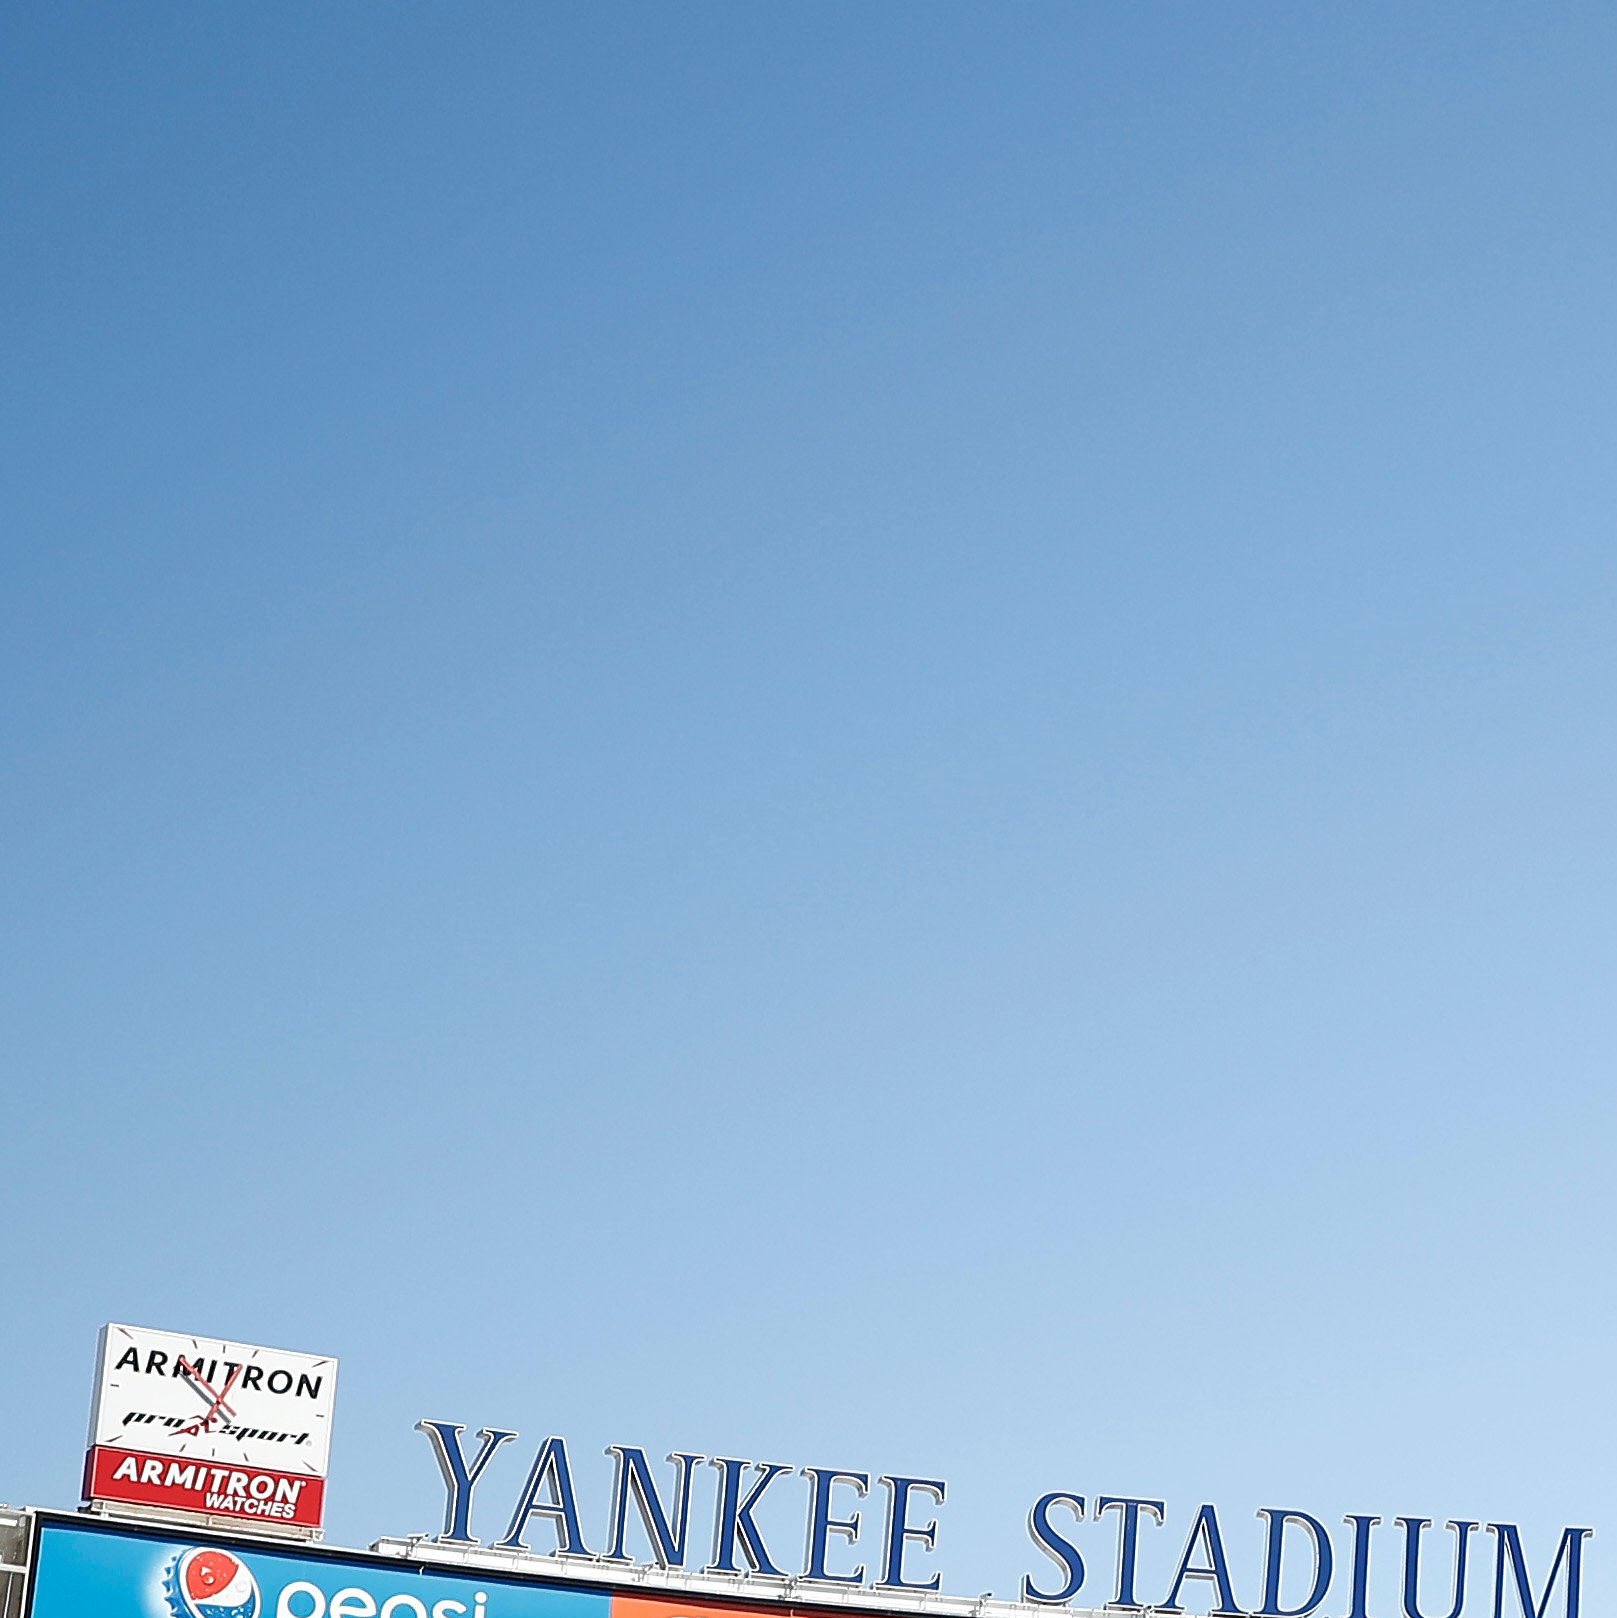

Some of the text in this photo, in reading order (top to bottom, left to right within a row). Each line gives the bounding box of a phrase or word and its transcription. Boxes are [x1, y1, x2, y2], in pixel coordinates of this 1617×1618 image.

[115, 1347, 323, 1399] ARMITRON
[113, 1457, 306, 1504] ARMITRON
[415, 1419, 947, 1591] YANKEE
[205, 1493, 297, 1519] WATCHES
